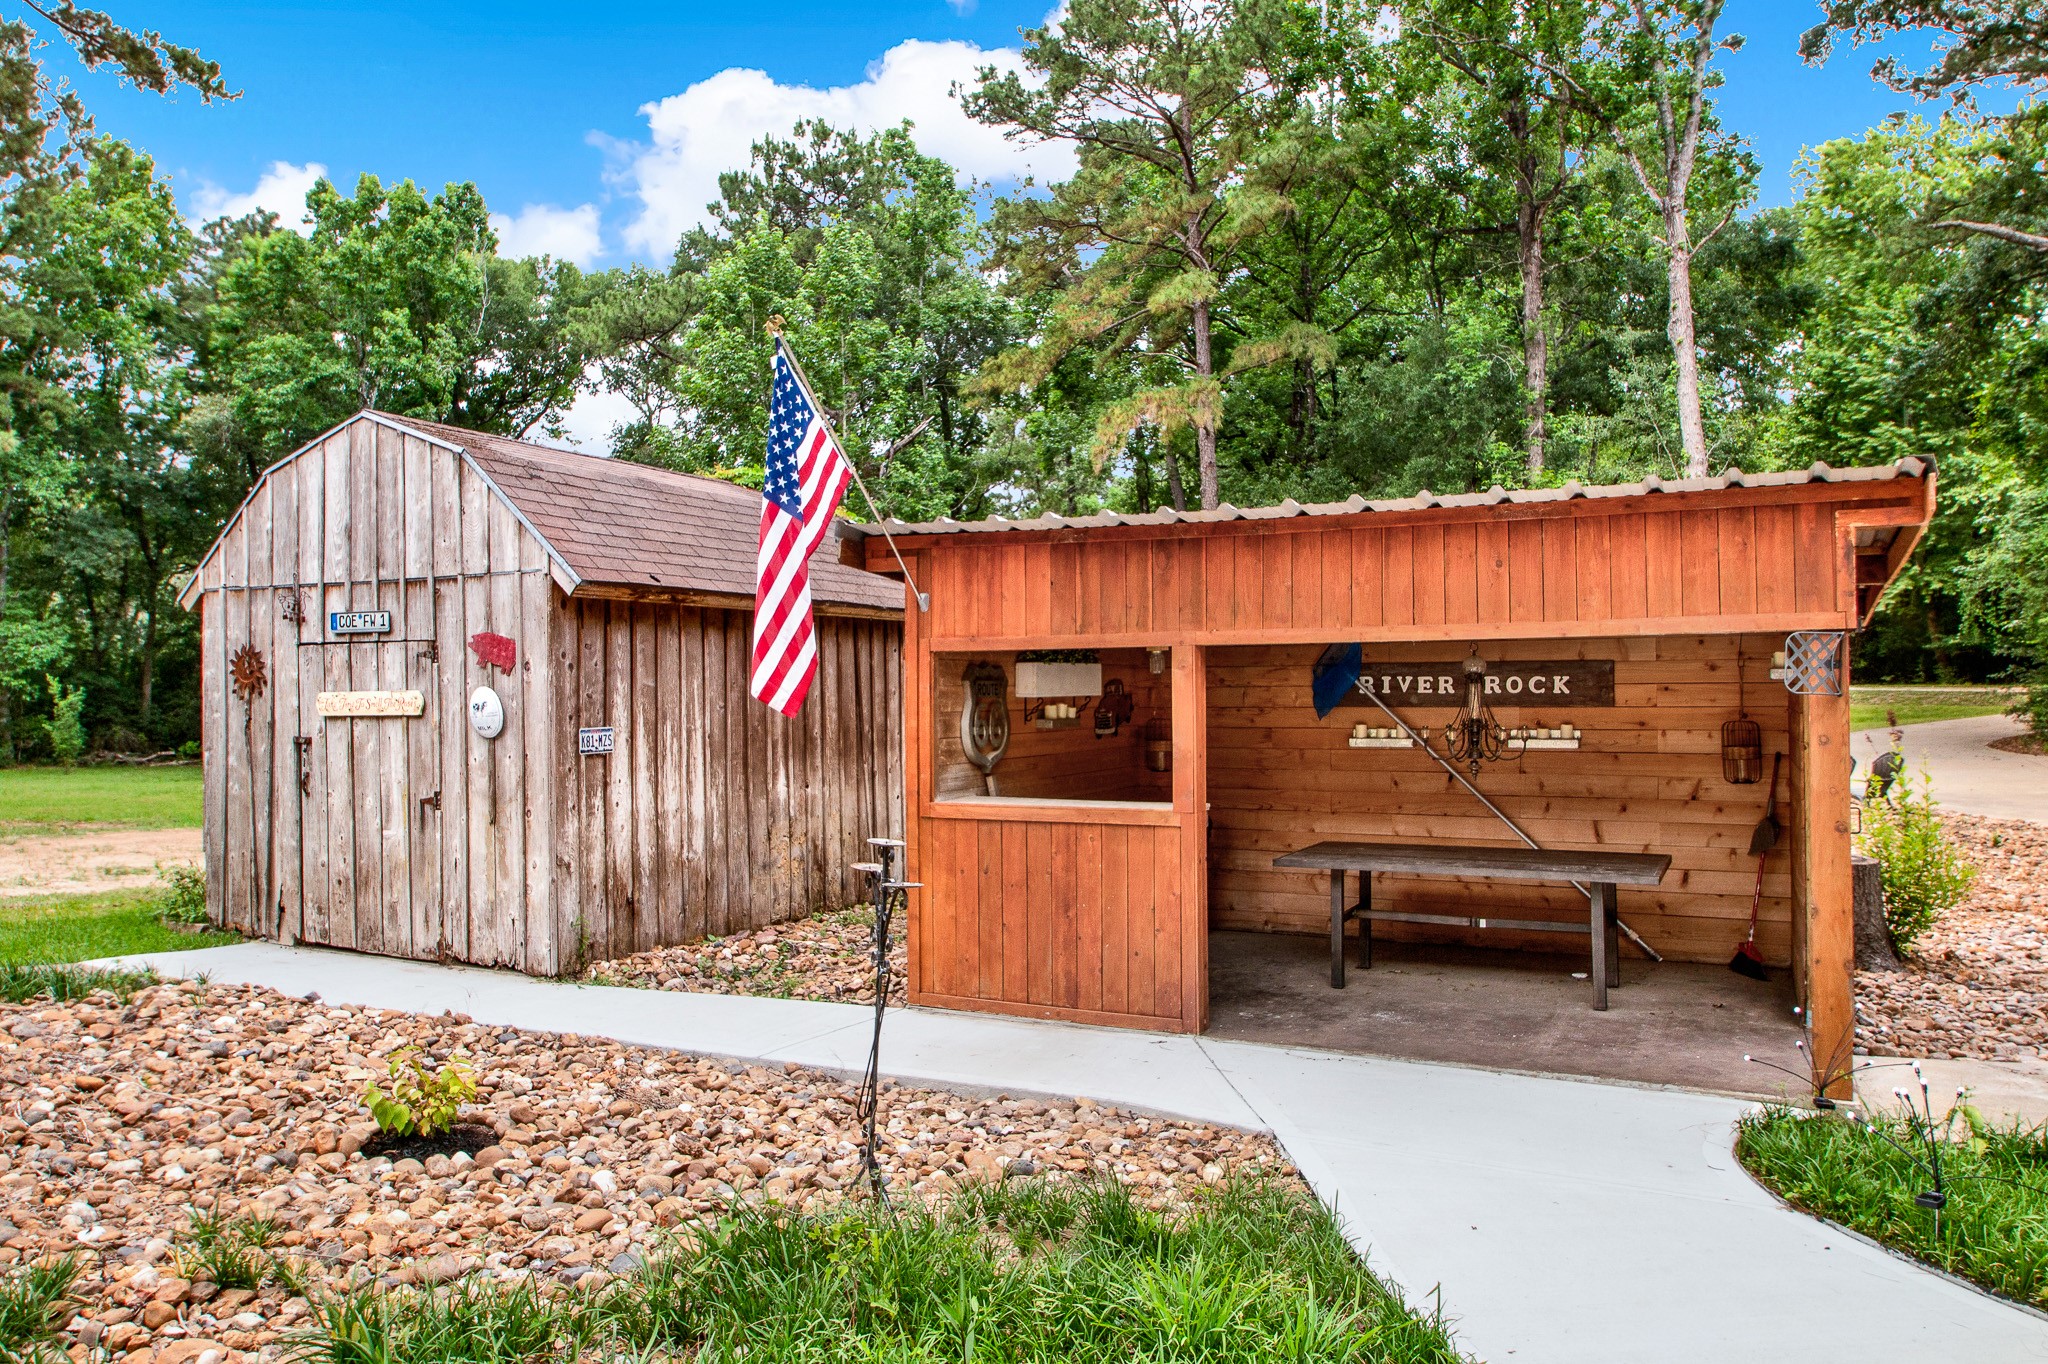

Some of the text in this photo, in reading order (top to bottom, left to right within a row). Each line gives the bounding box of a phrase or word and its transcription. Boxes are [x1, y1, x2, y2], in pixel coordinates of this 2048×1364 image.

[339, 614, 386, 628] COE FW 1
[977, 683, 999, 696] ROUTE
[1359, 676, 1570, 694] RIVER ROCK
[974, 703, 1002, 748] 66
